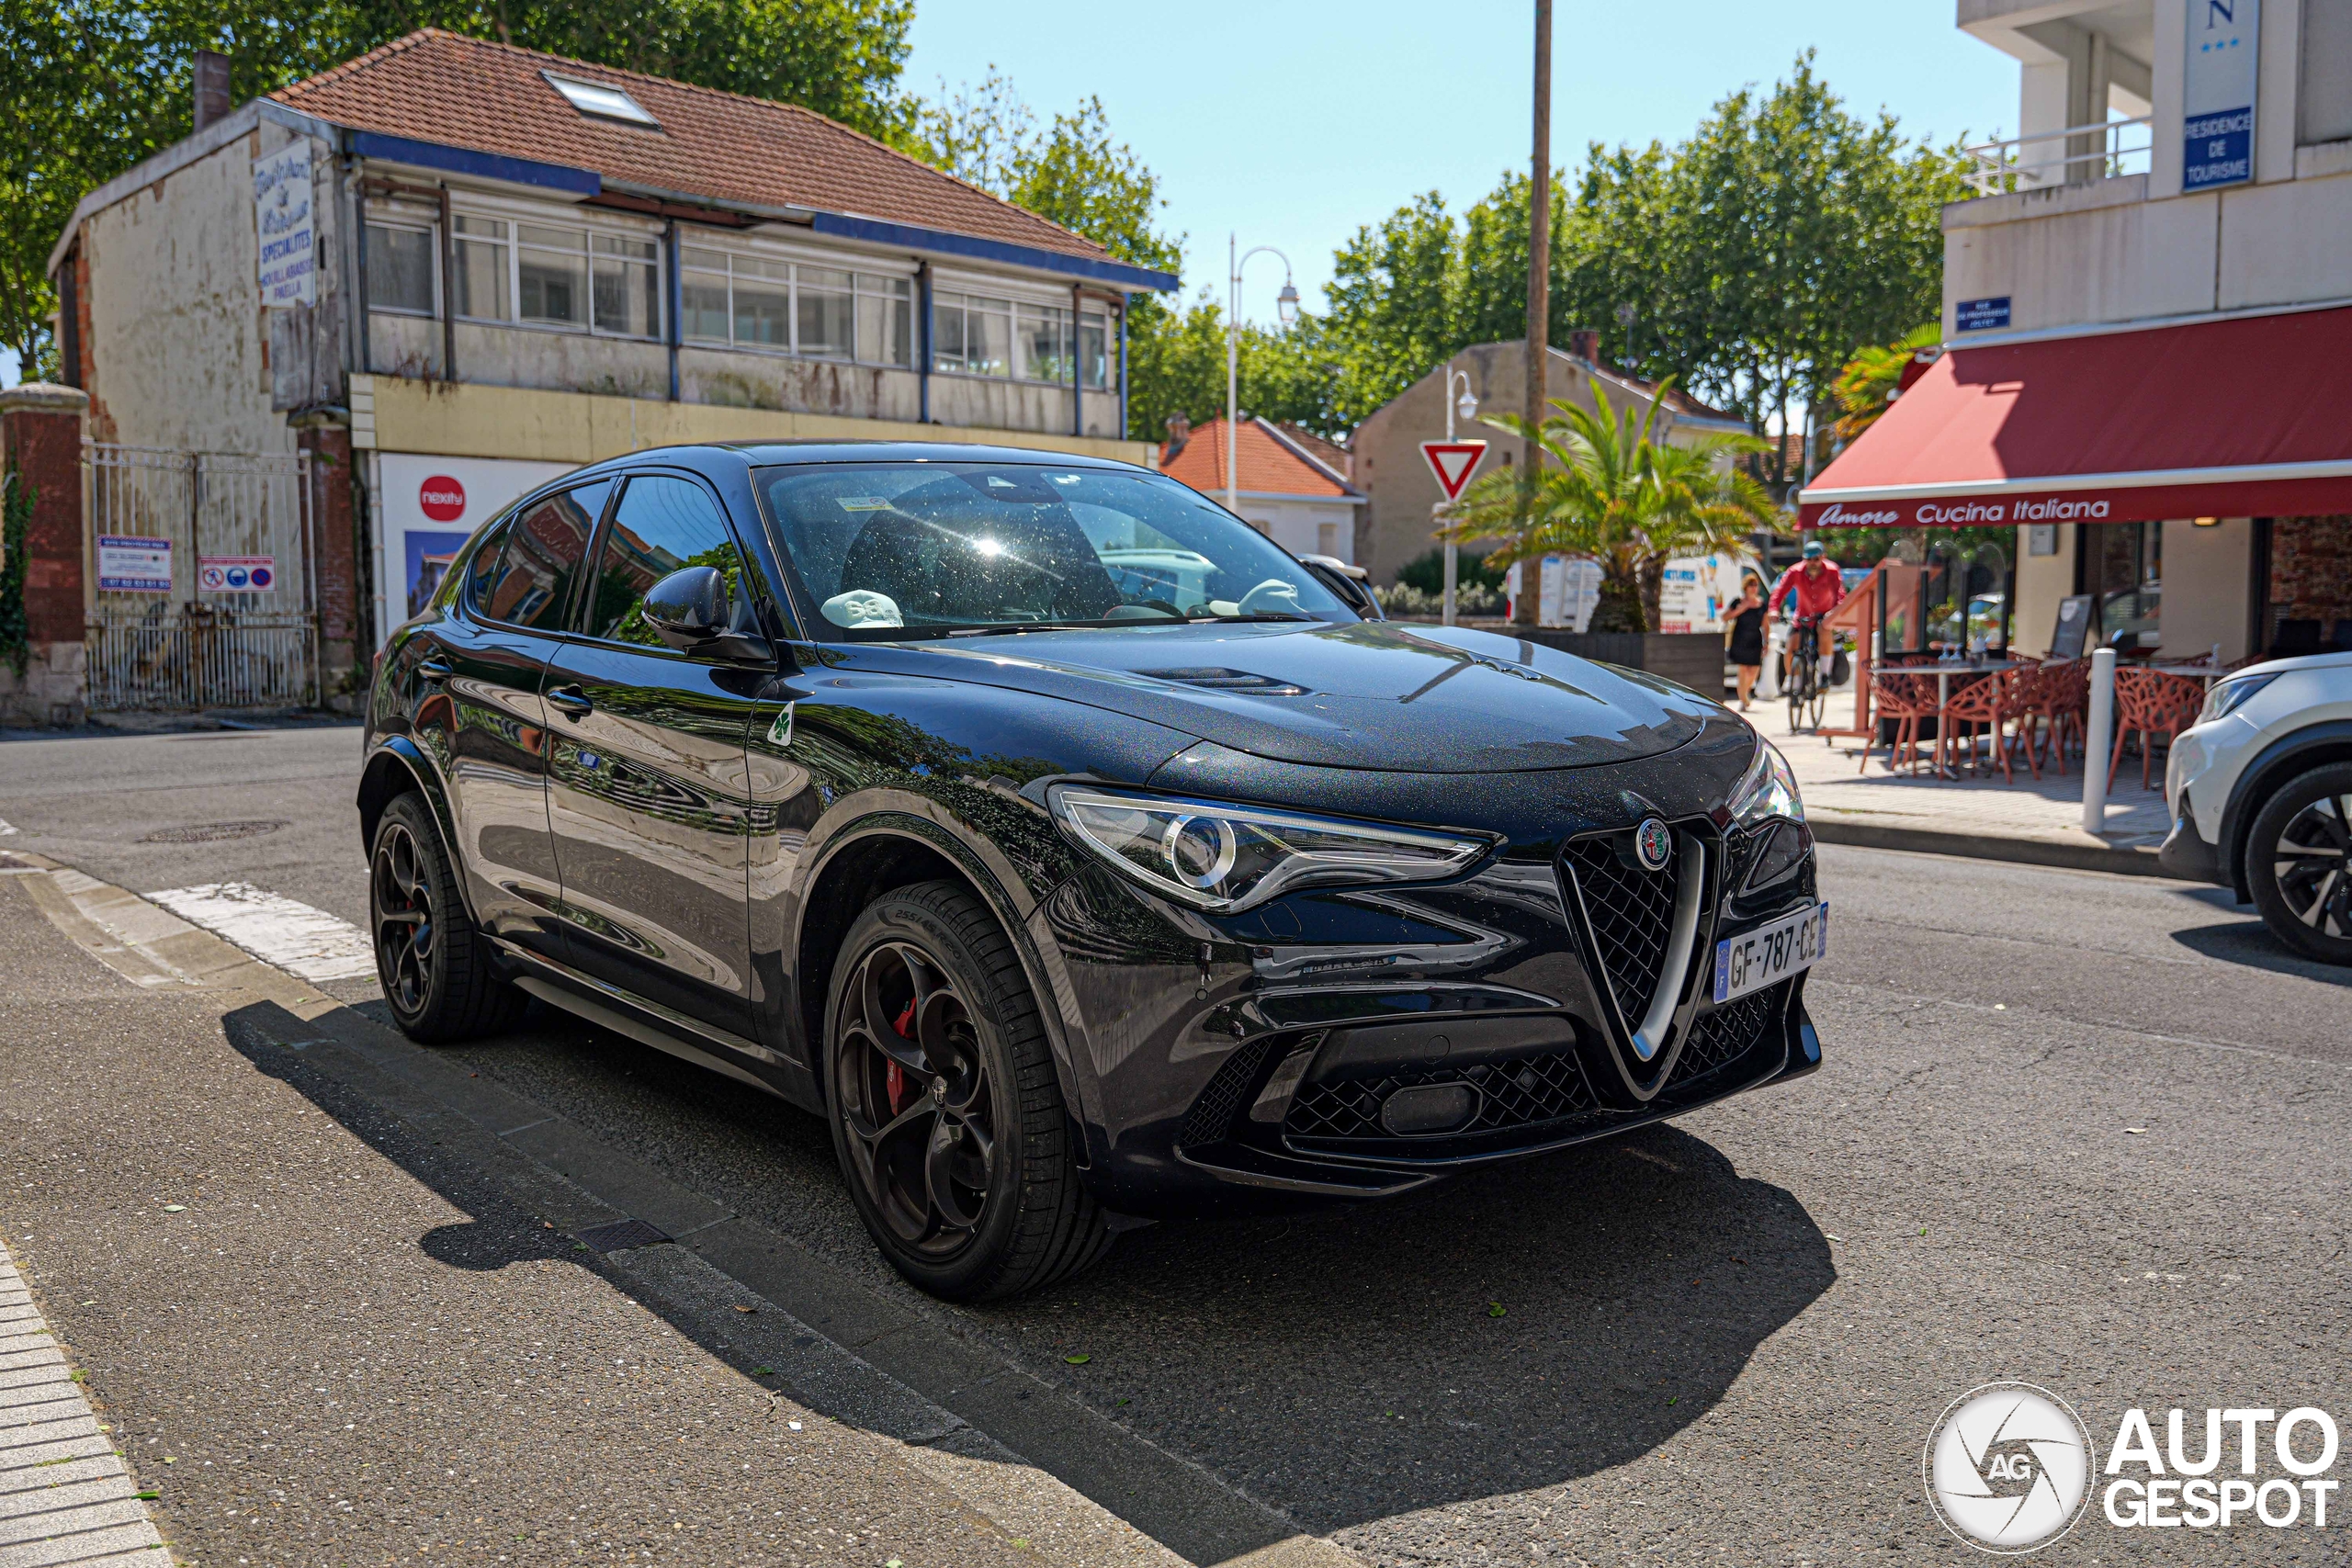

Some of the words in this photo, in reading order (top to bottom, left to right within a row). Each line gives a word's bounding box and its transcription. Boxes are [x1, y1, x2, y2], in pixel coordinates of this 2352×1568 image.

[2185, 113, 2251, 139] RESIDENCE
[2209, 139, 2226, 158] DE
[2187, 158, 2247, 183] TOURISME
[274, 280, 302, 299] PAELLA
[423, 491, 463, 505] nexity
[1816, 503, 1899, 526] Amore
[1916, 502, 2005, 523] Cucina
[2013, 498, 2110, 520] Italiana
[1719, 976, 1724, 989] F
[1730, 915, 1818, 989] GF-787-CE
